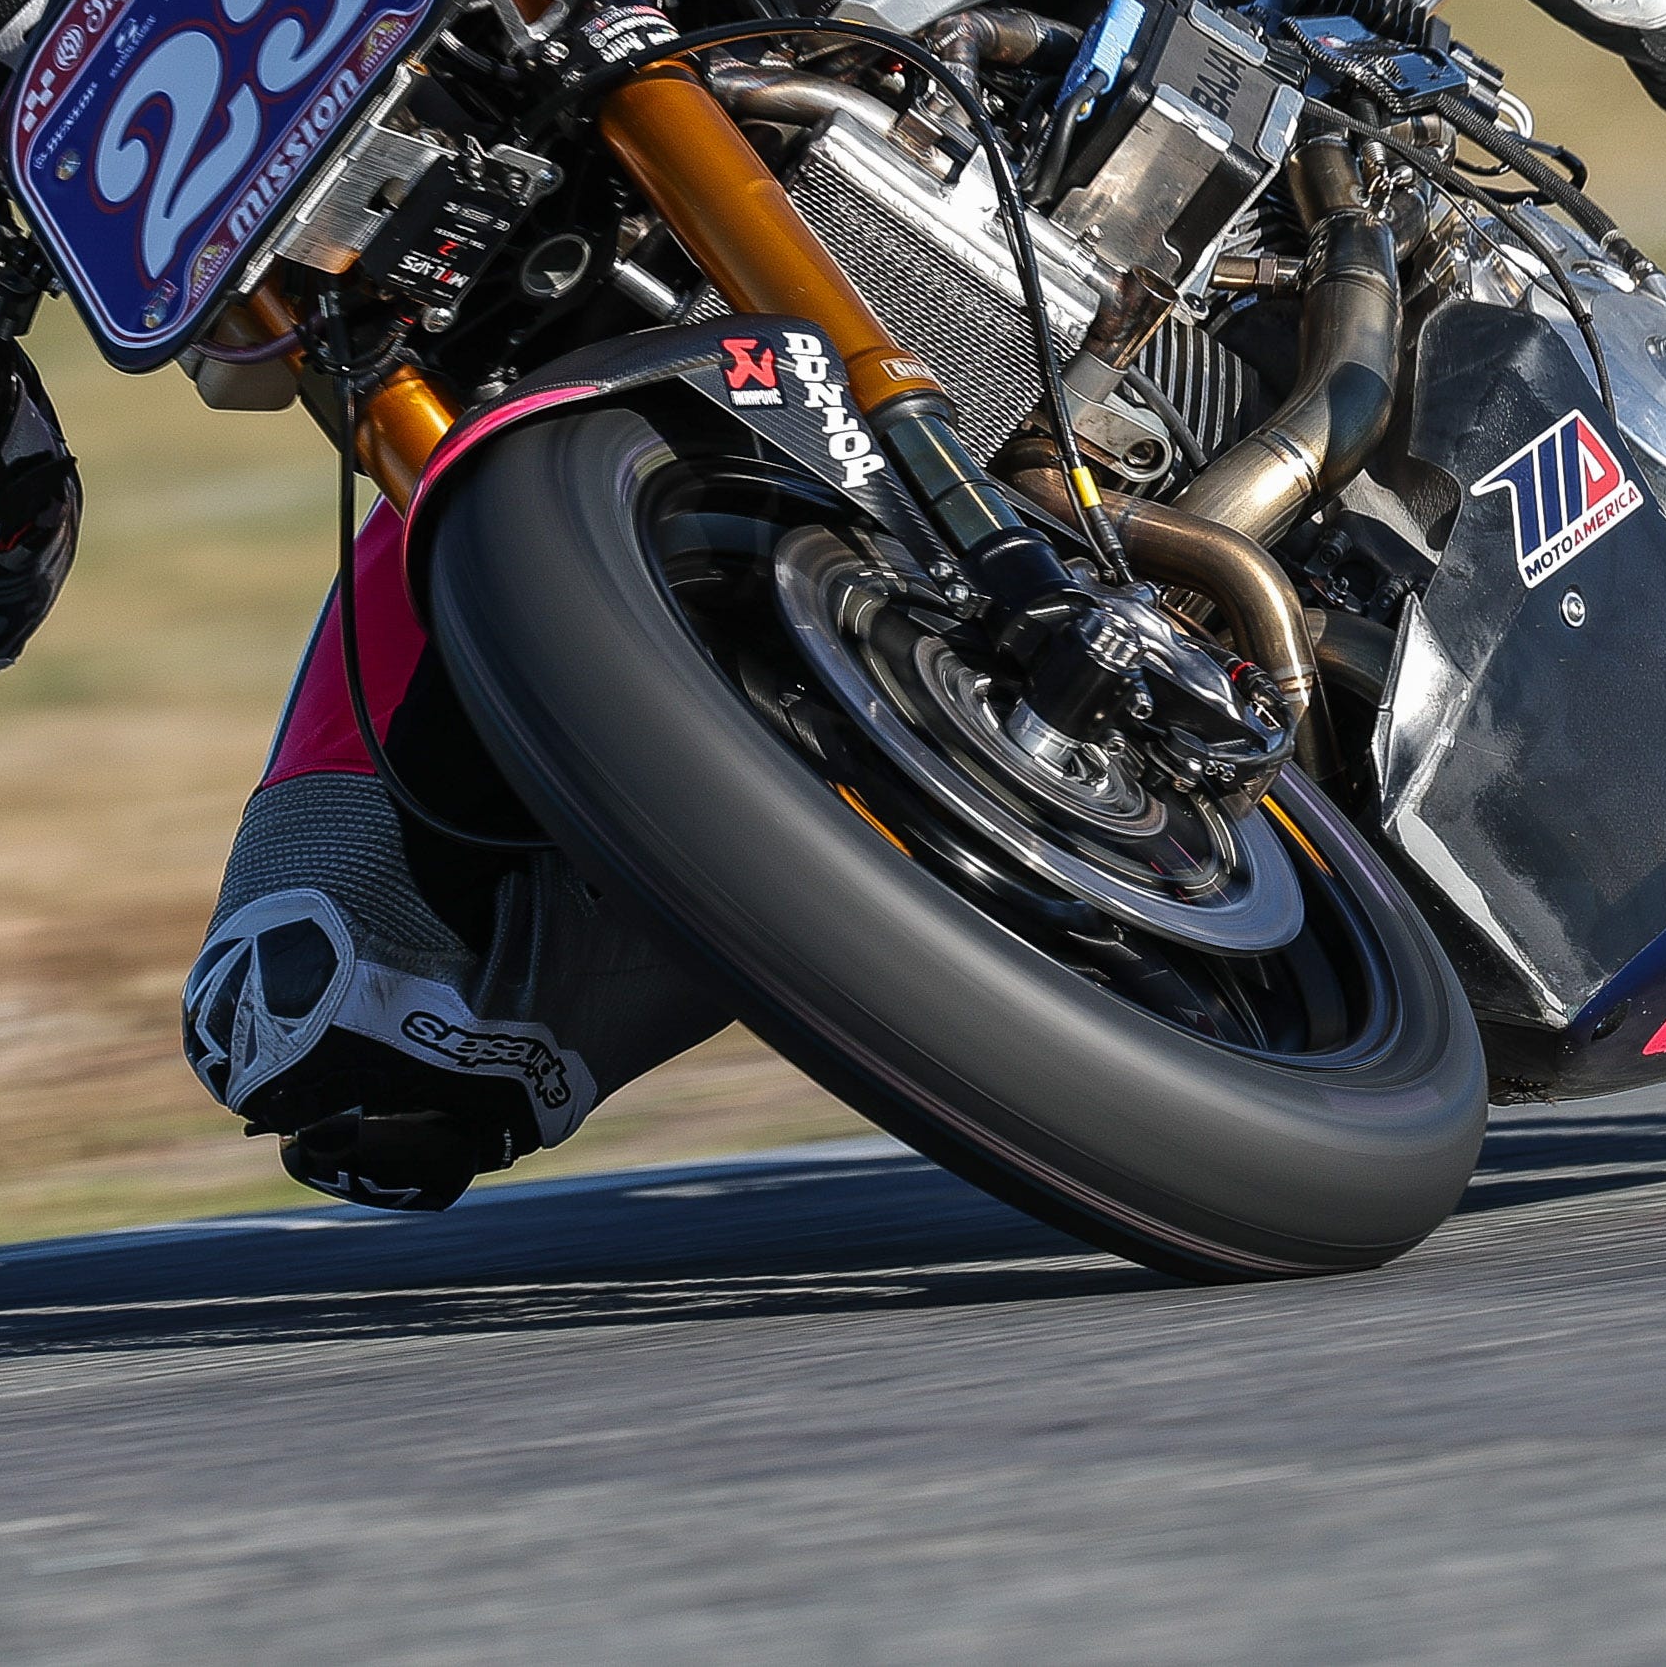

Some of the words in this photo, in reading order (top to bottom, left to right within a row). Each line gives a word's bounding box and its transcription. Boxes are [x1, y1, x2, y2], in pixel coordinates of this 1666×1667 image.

[1190, 45, 1247, 120] BAJA
[782, 332, 886, 489] DUNLOP
[1524, 486, 1639, 581] MOTOAMERICA
